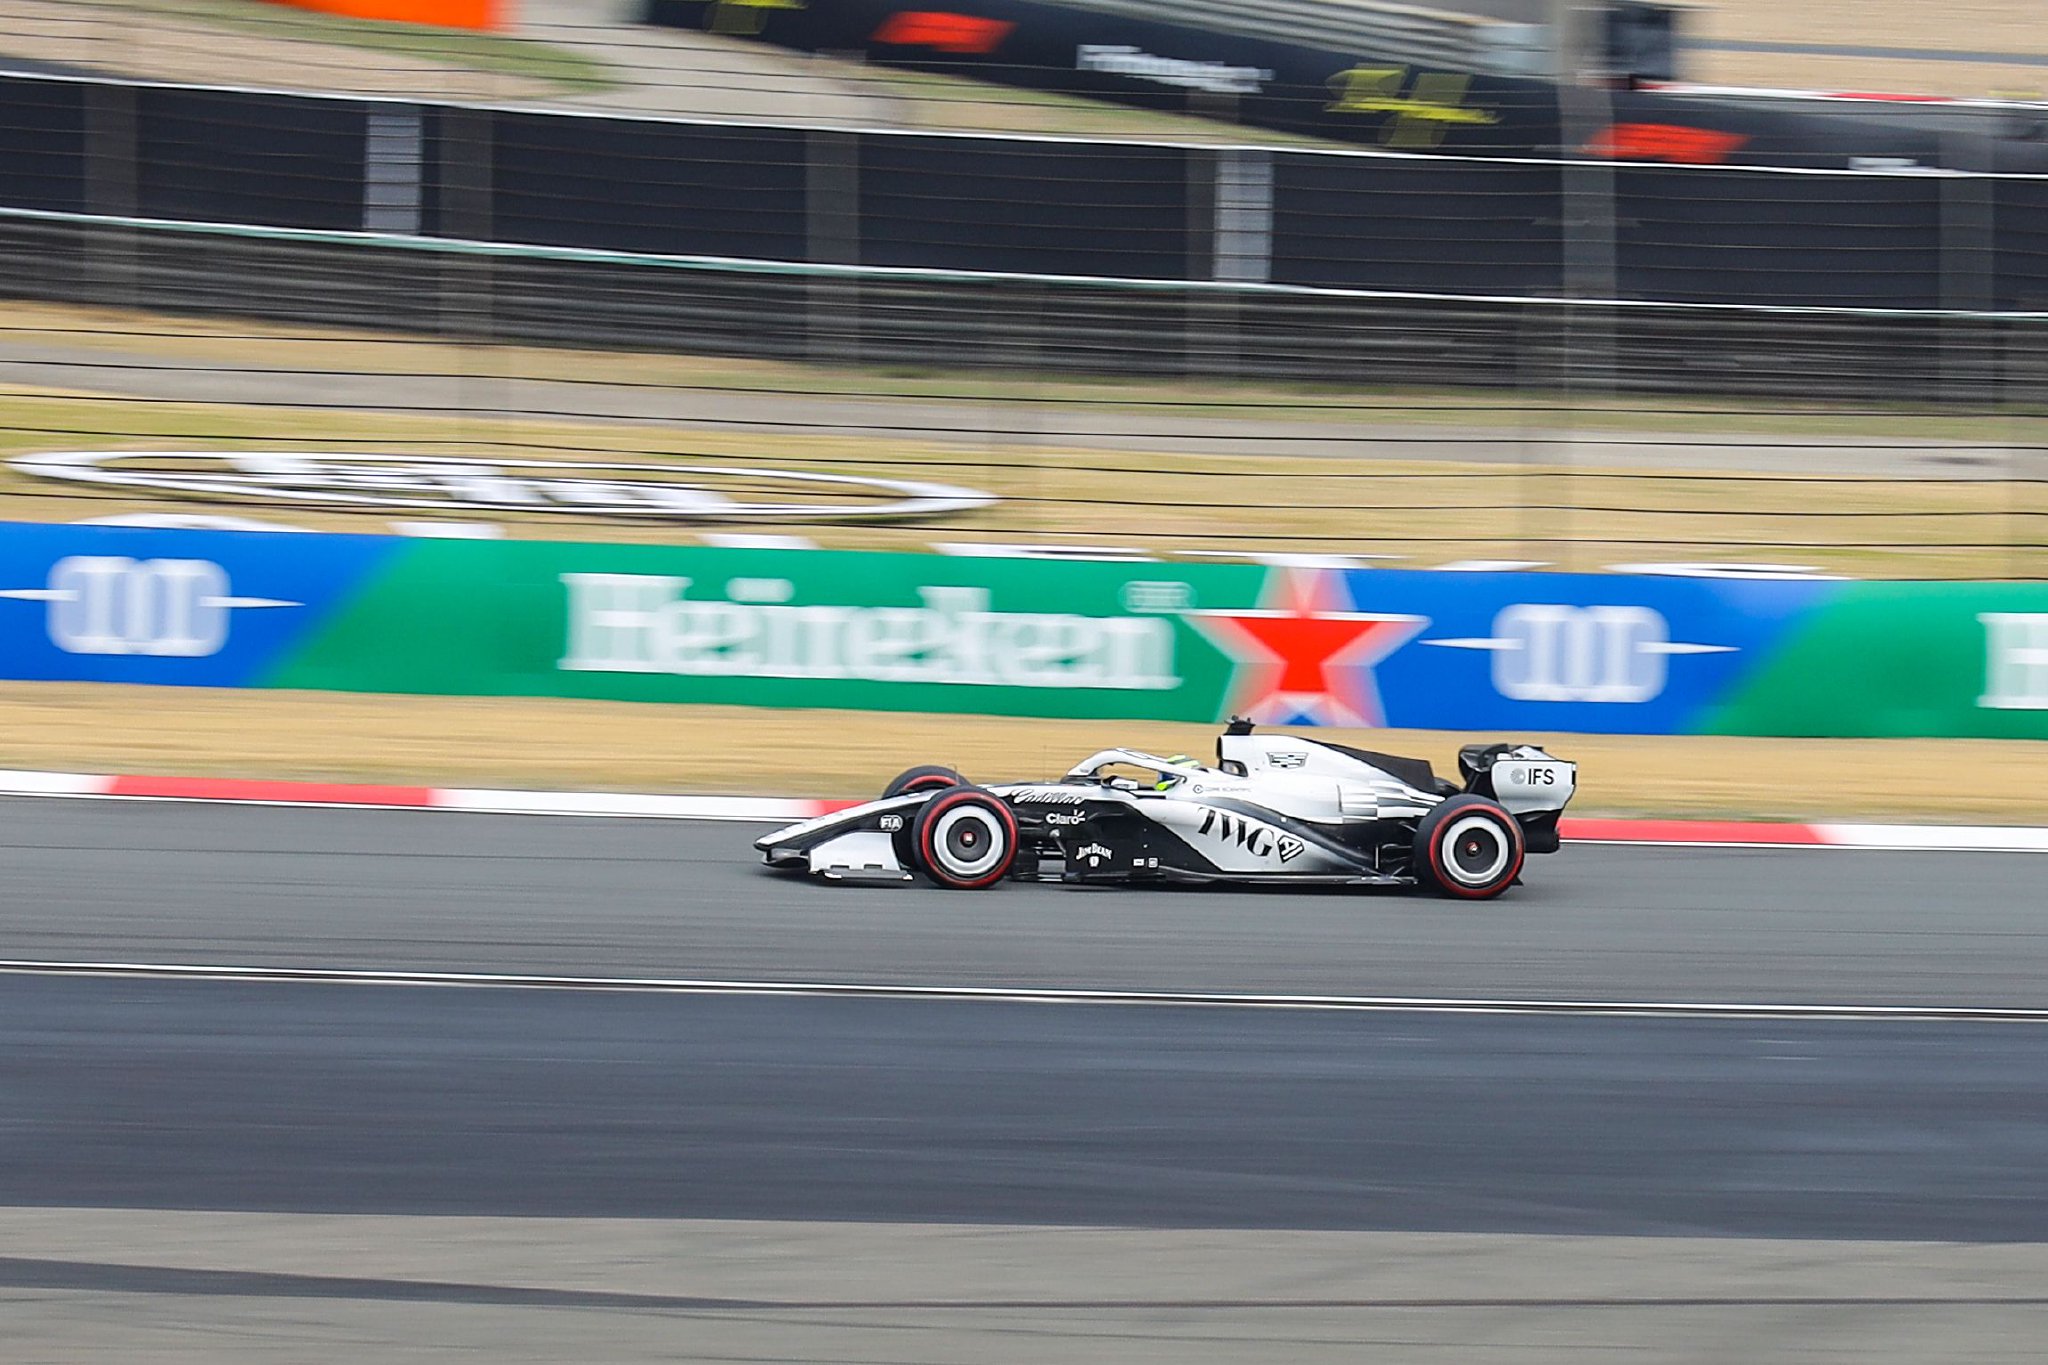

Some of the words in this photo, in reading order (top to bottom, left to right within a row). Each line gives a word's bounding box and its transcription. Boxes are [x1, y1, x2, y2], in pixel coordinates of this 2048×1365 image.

[558, 572, 1183, 690] Heineken
[1528, 768, 1554, 785] IFS
[1011, 789, 1084, 805] Cadillac
[881, 815, 903, 831] FIA
[1046, 810, 1085, 825] Claro
[1198, 807, 1274, 857] TWG
